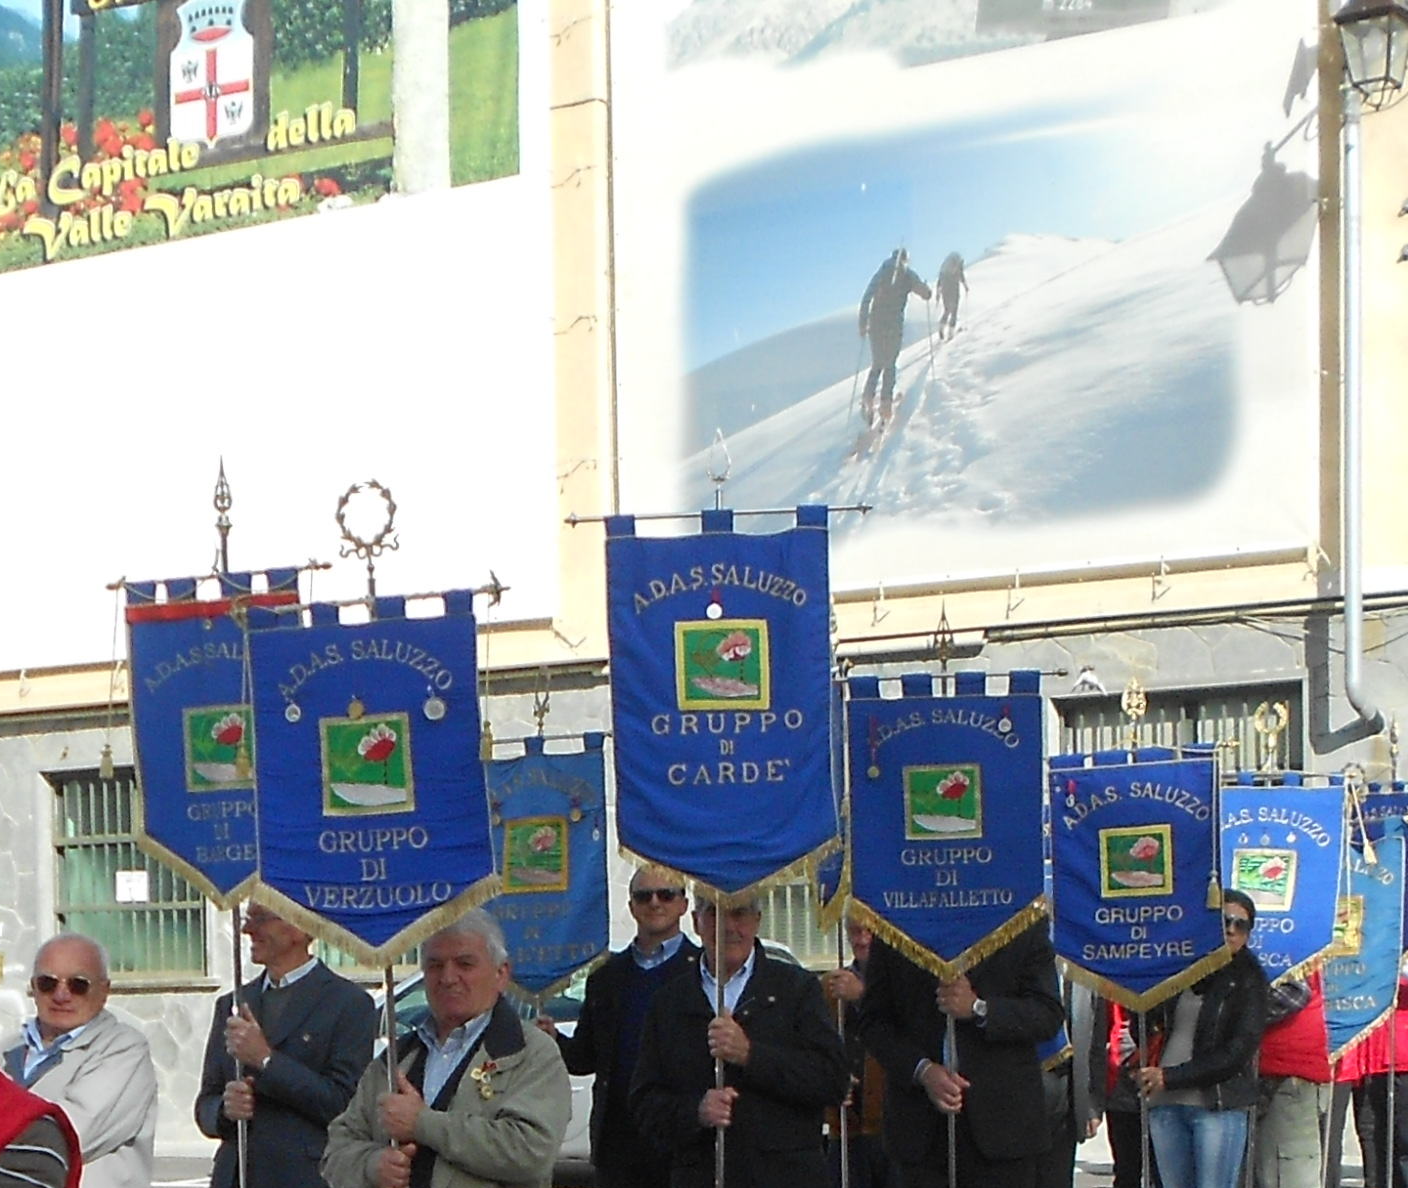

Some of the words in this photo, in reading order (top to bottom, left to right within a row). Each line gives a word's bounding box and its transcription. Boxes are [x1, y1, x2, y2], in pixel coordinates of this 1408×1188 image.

[48, 137, 200, 205] Capitale
[266, 101, 357, 152] della
[22, 203, 133, 261] Valle
[143, 174, 302, 241] Varaita
[710, 562, 808, 607] SALUZZO
[351, 639, 453, 690] SALUZZO
[650, 709, 804, 736] GRUPPO
[719, 740, 734, 755] DI
[1129, 782, 1210, 821] SALUZZO
[318, 826, 429, 854] GRUPPO
[1258, 806, 1331, 848] SALUZZO
[360, 857, 387, 882] DI
[900, 848, 993, 866] GRUPPO
[936, 869, 958, 886] DI
[303, 883, 452, 910] VERZUOLO
[882, 891, 1013, 909] VILLAFALLETTO
[1094, 904, 1184, 925] GRUPPO
[1129, 925, 1148, 941] DI
[1081, 939, 1196, 961] SAMPEYRE
